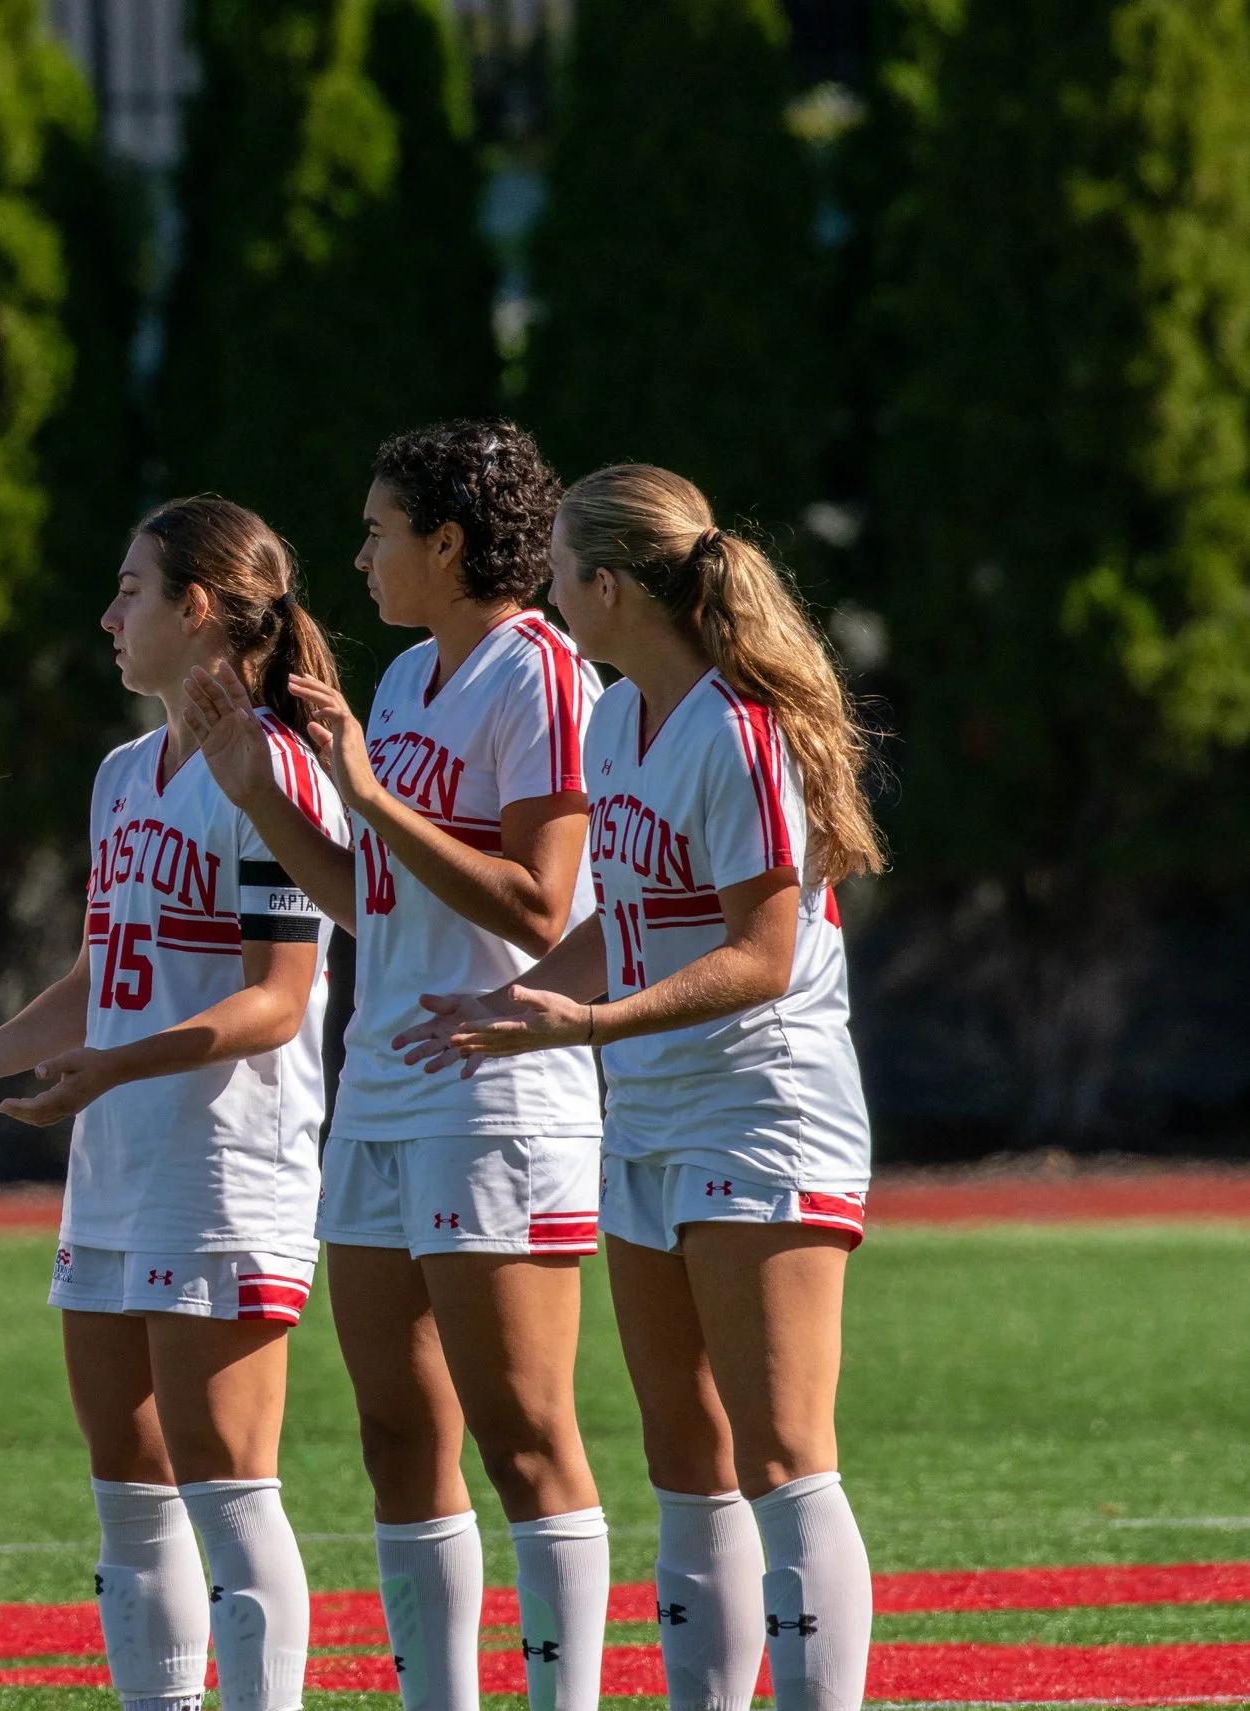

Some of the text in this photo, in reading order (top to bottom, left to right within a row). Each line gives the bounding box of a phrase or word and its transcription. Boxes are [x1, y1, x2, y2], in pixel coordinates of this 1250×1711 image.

[589, 794, 696, 893] OSTON
[269, 893, 319, 912] CAPTA
[99, 923, 153, 1011] 15
